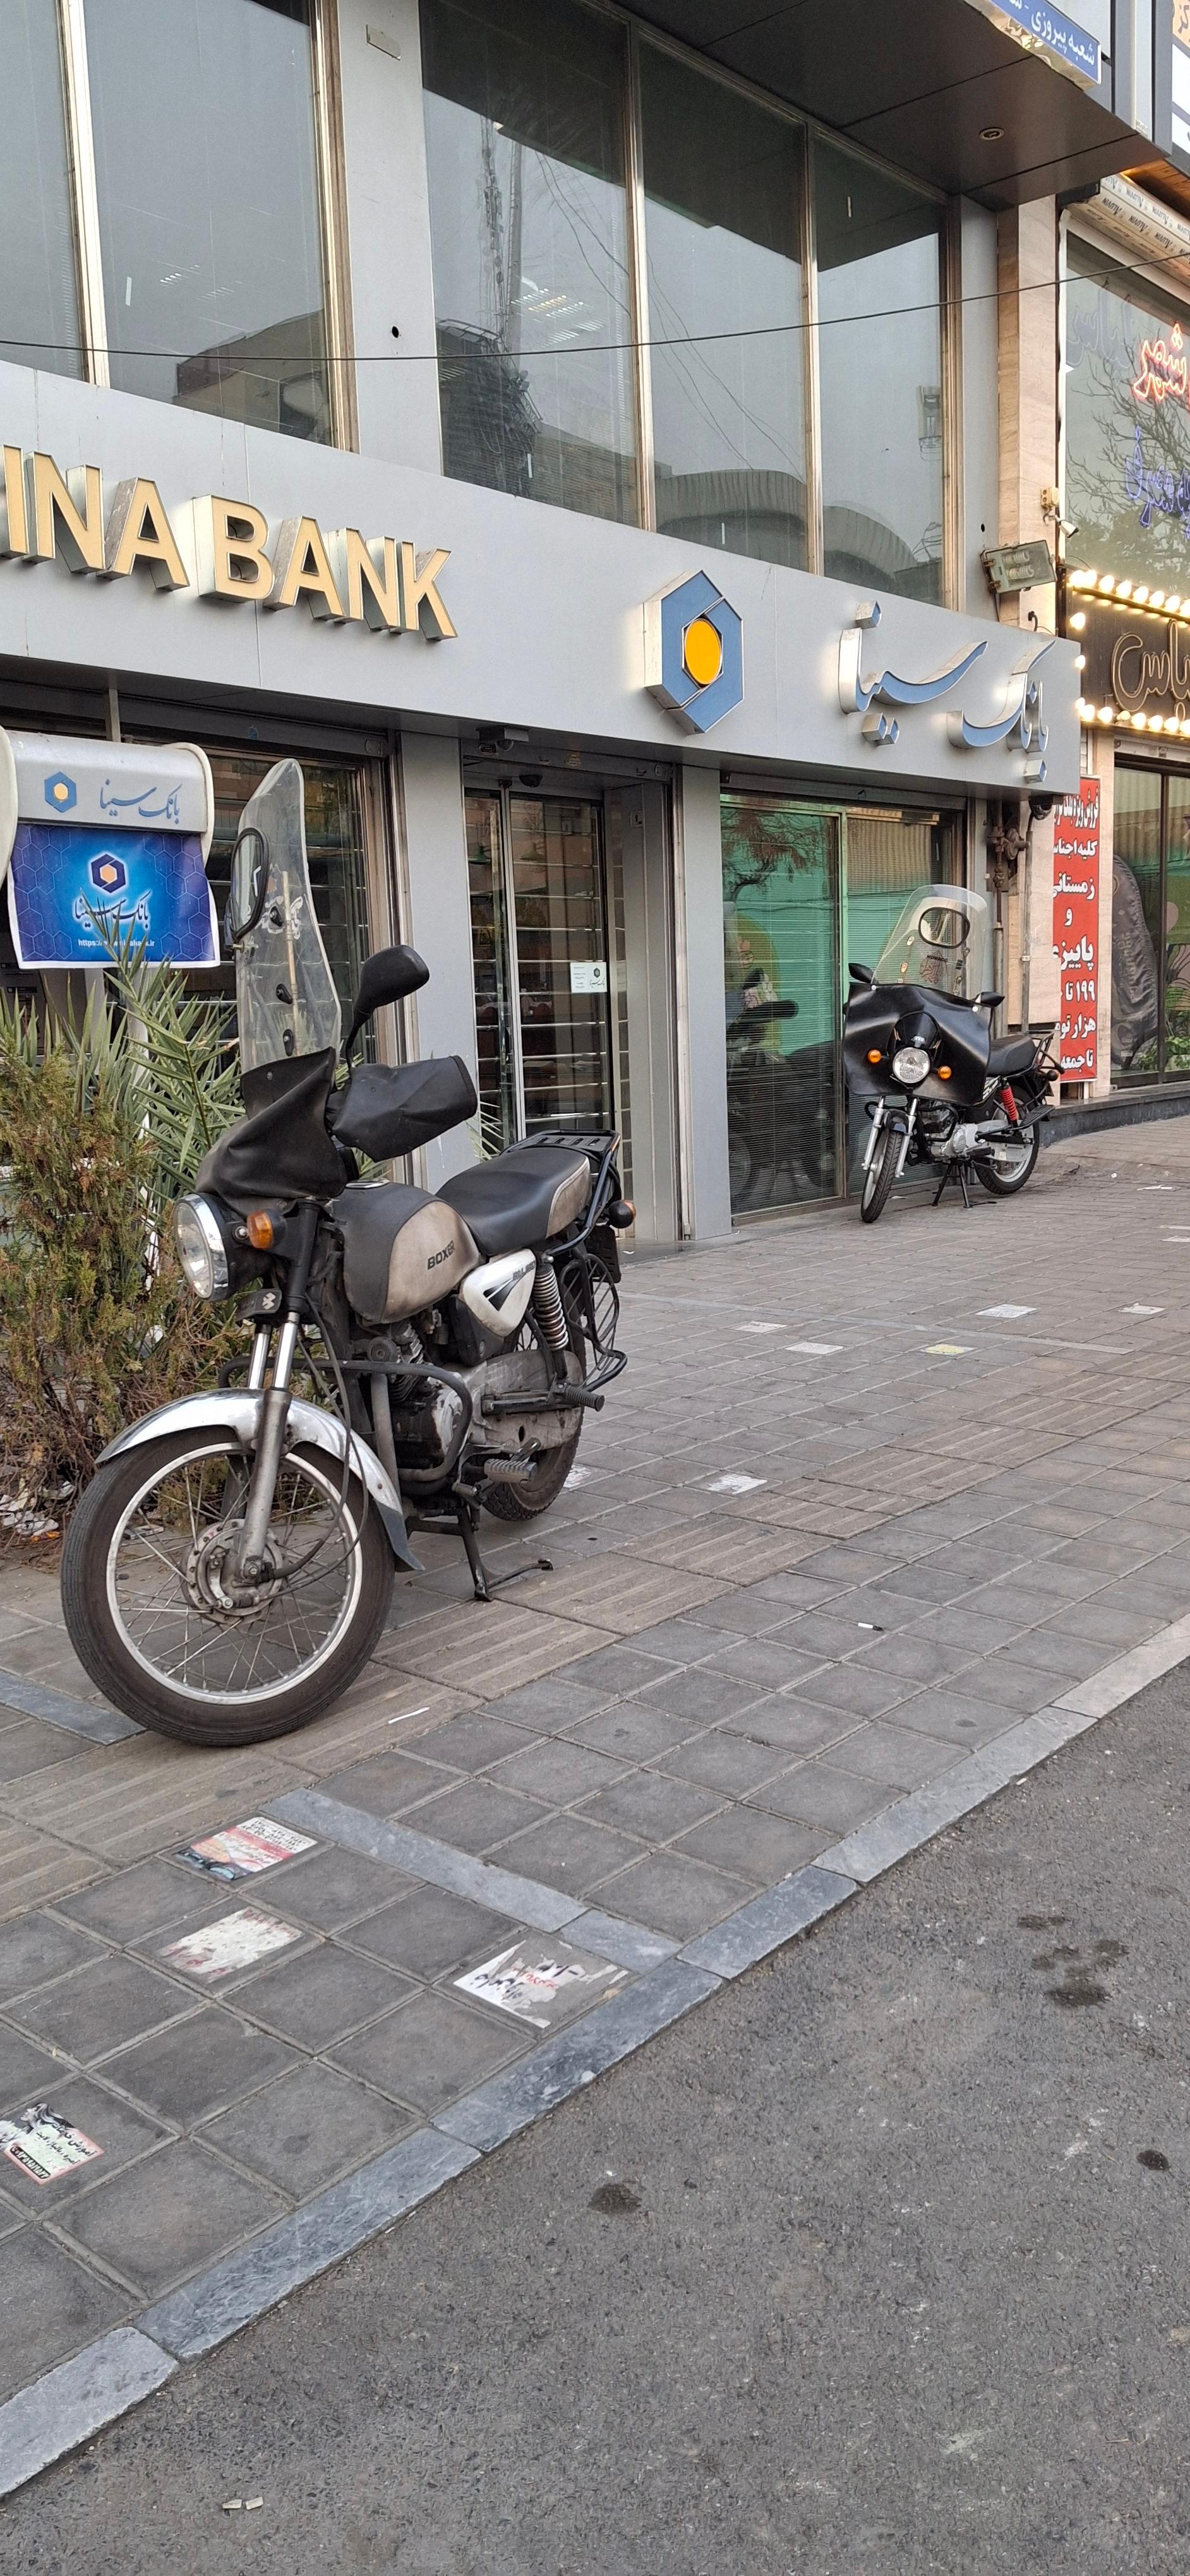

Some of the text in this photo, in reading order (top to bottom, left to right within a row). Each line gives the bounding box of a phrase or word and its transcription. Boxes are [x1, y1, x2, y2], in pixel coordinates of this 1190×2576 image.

[1031, 11, 1095, 65] شعبه پیروزی
[0, 445, 458, 641] INA BANK
[843, 600, 1056, 784] بانک سینا
[99, 778, 183, 825] بانک سینا
[1073, 794, 1084, 828] ویژه
[1083, 787, 1098, 828] فروش
[1078, 838, 1098, 861] کلیه
[75, 890, 151, 929] بانک سینا
[1064, 907, 1073, 926] و
[1065, 979, 1096, 1002] ۱۹۹ تا
[1071, 1013, 1097, 1039] هزار
[1061, 1047, 1094, 1073] تا جمعه
[427, 1239, 455, 1270] BOXER
[68, 2138, 98, 2157] آموزش
